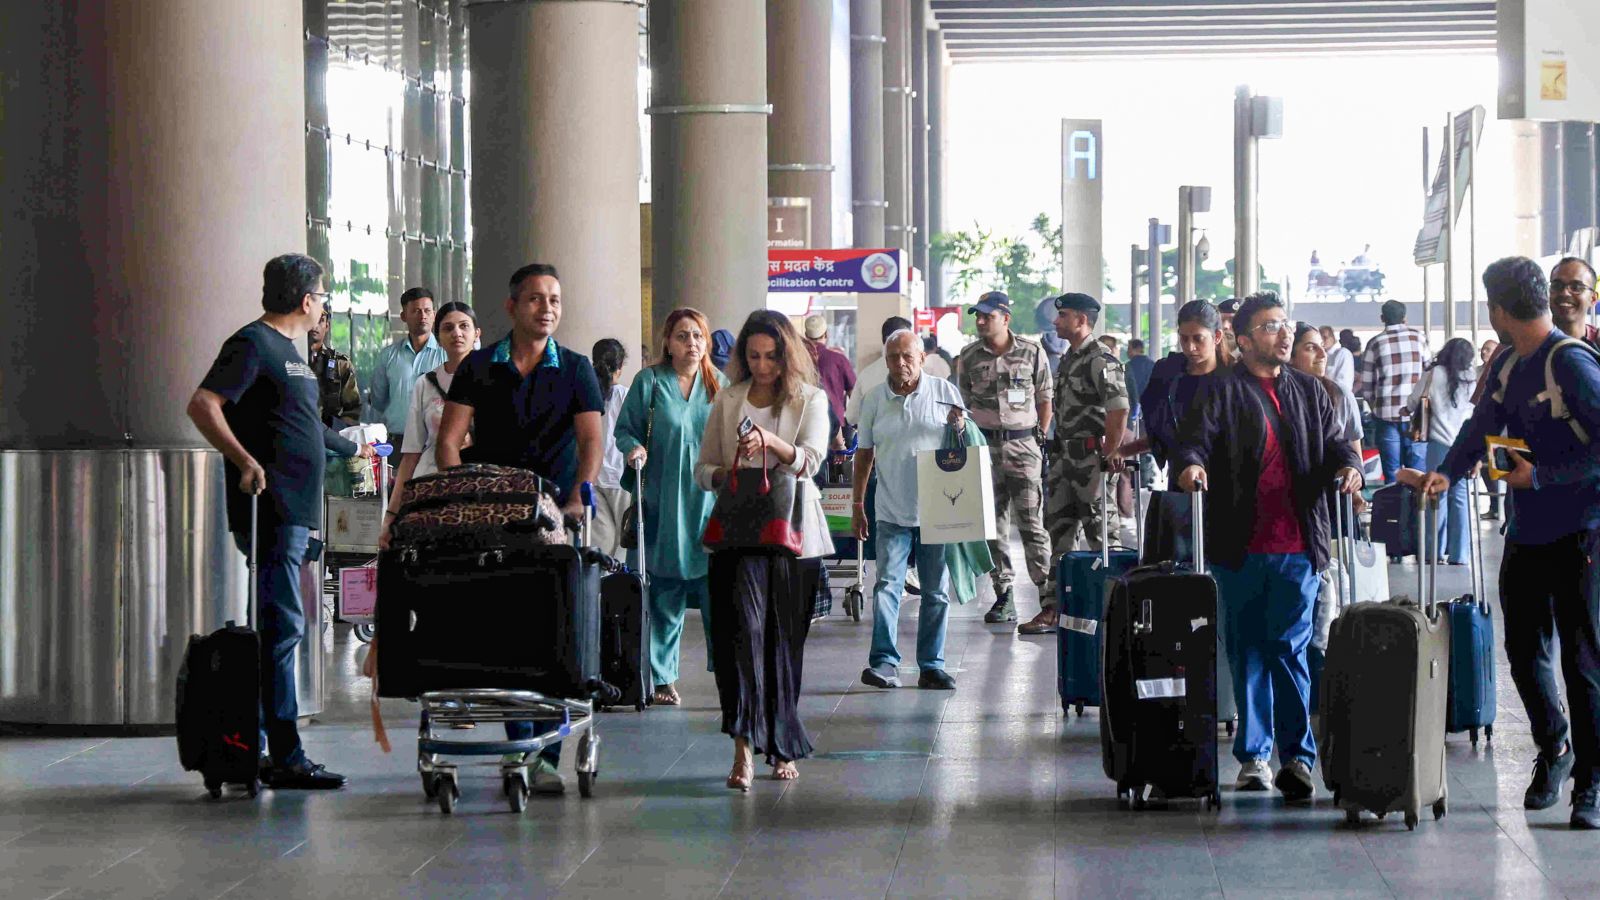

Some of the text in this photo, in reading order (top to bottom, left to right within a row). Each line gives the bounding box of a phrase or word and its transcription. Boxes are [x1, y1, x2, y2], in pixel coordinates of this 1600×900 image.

[1070, 130, 1096, 179] A
[776, 217, 784, 233] I
[783, 260, 810, 272] मदत
[818, 277, 854, 287] Centre
